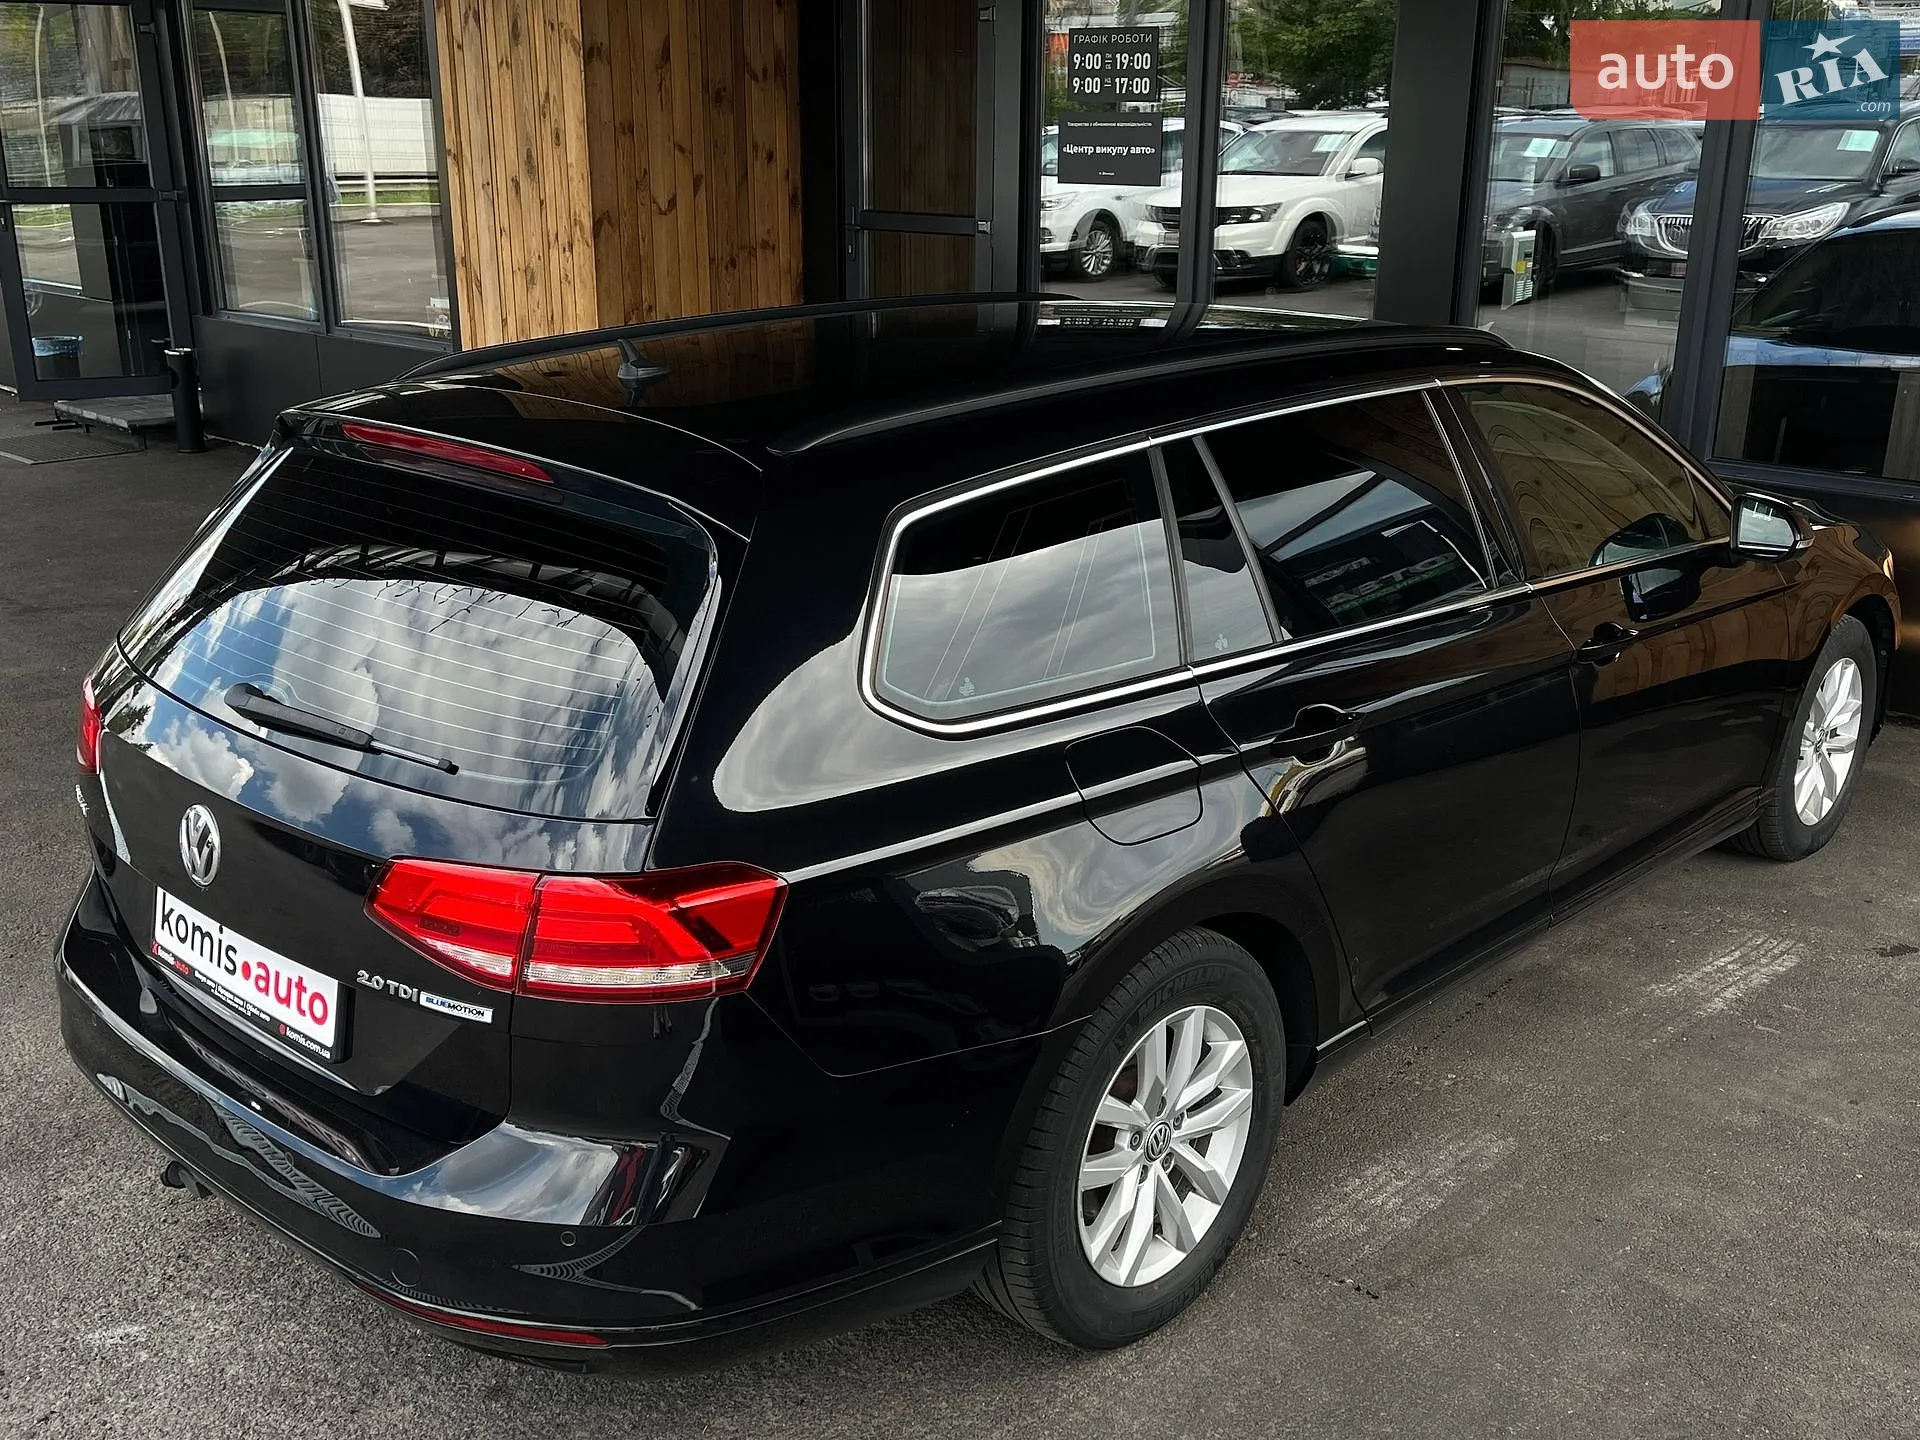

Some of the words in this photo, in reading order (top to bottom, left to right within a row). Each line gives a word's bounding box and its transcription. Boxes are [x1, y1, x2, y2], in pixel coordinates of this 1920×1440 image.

[1073, 34, 1108, 43] ГРАФІК
[1111, 33, 1152, 43] РОБОТИ
[1073, 53, 1101, 70] 9:00
[1115, 52, 1151, 70] 19:00
[1072, 77, 1101, 94] 9:00
[1114, 77, 1150, 94] 17:00
[1062, 144, 1094, 155] «Центр
[1095, 146, 1128, 156] викупу
[1130, 146, 1155, 154] авто»
[386, 980, 419, 1003] TDI
[425, 996, 485, 1018] BLUEMOTION
[286, 1026, 331, 1059] komis.com.ua
